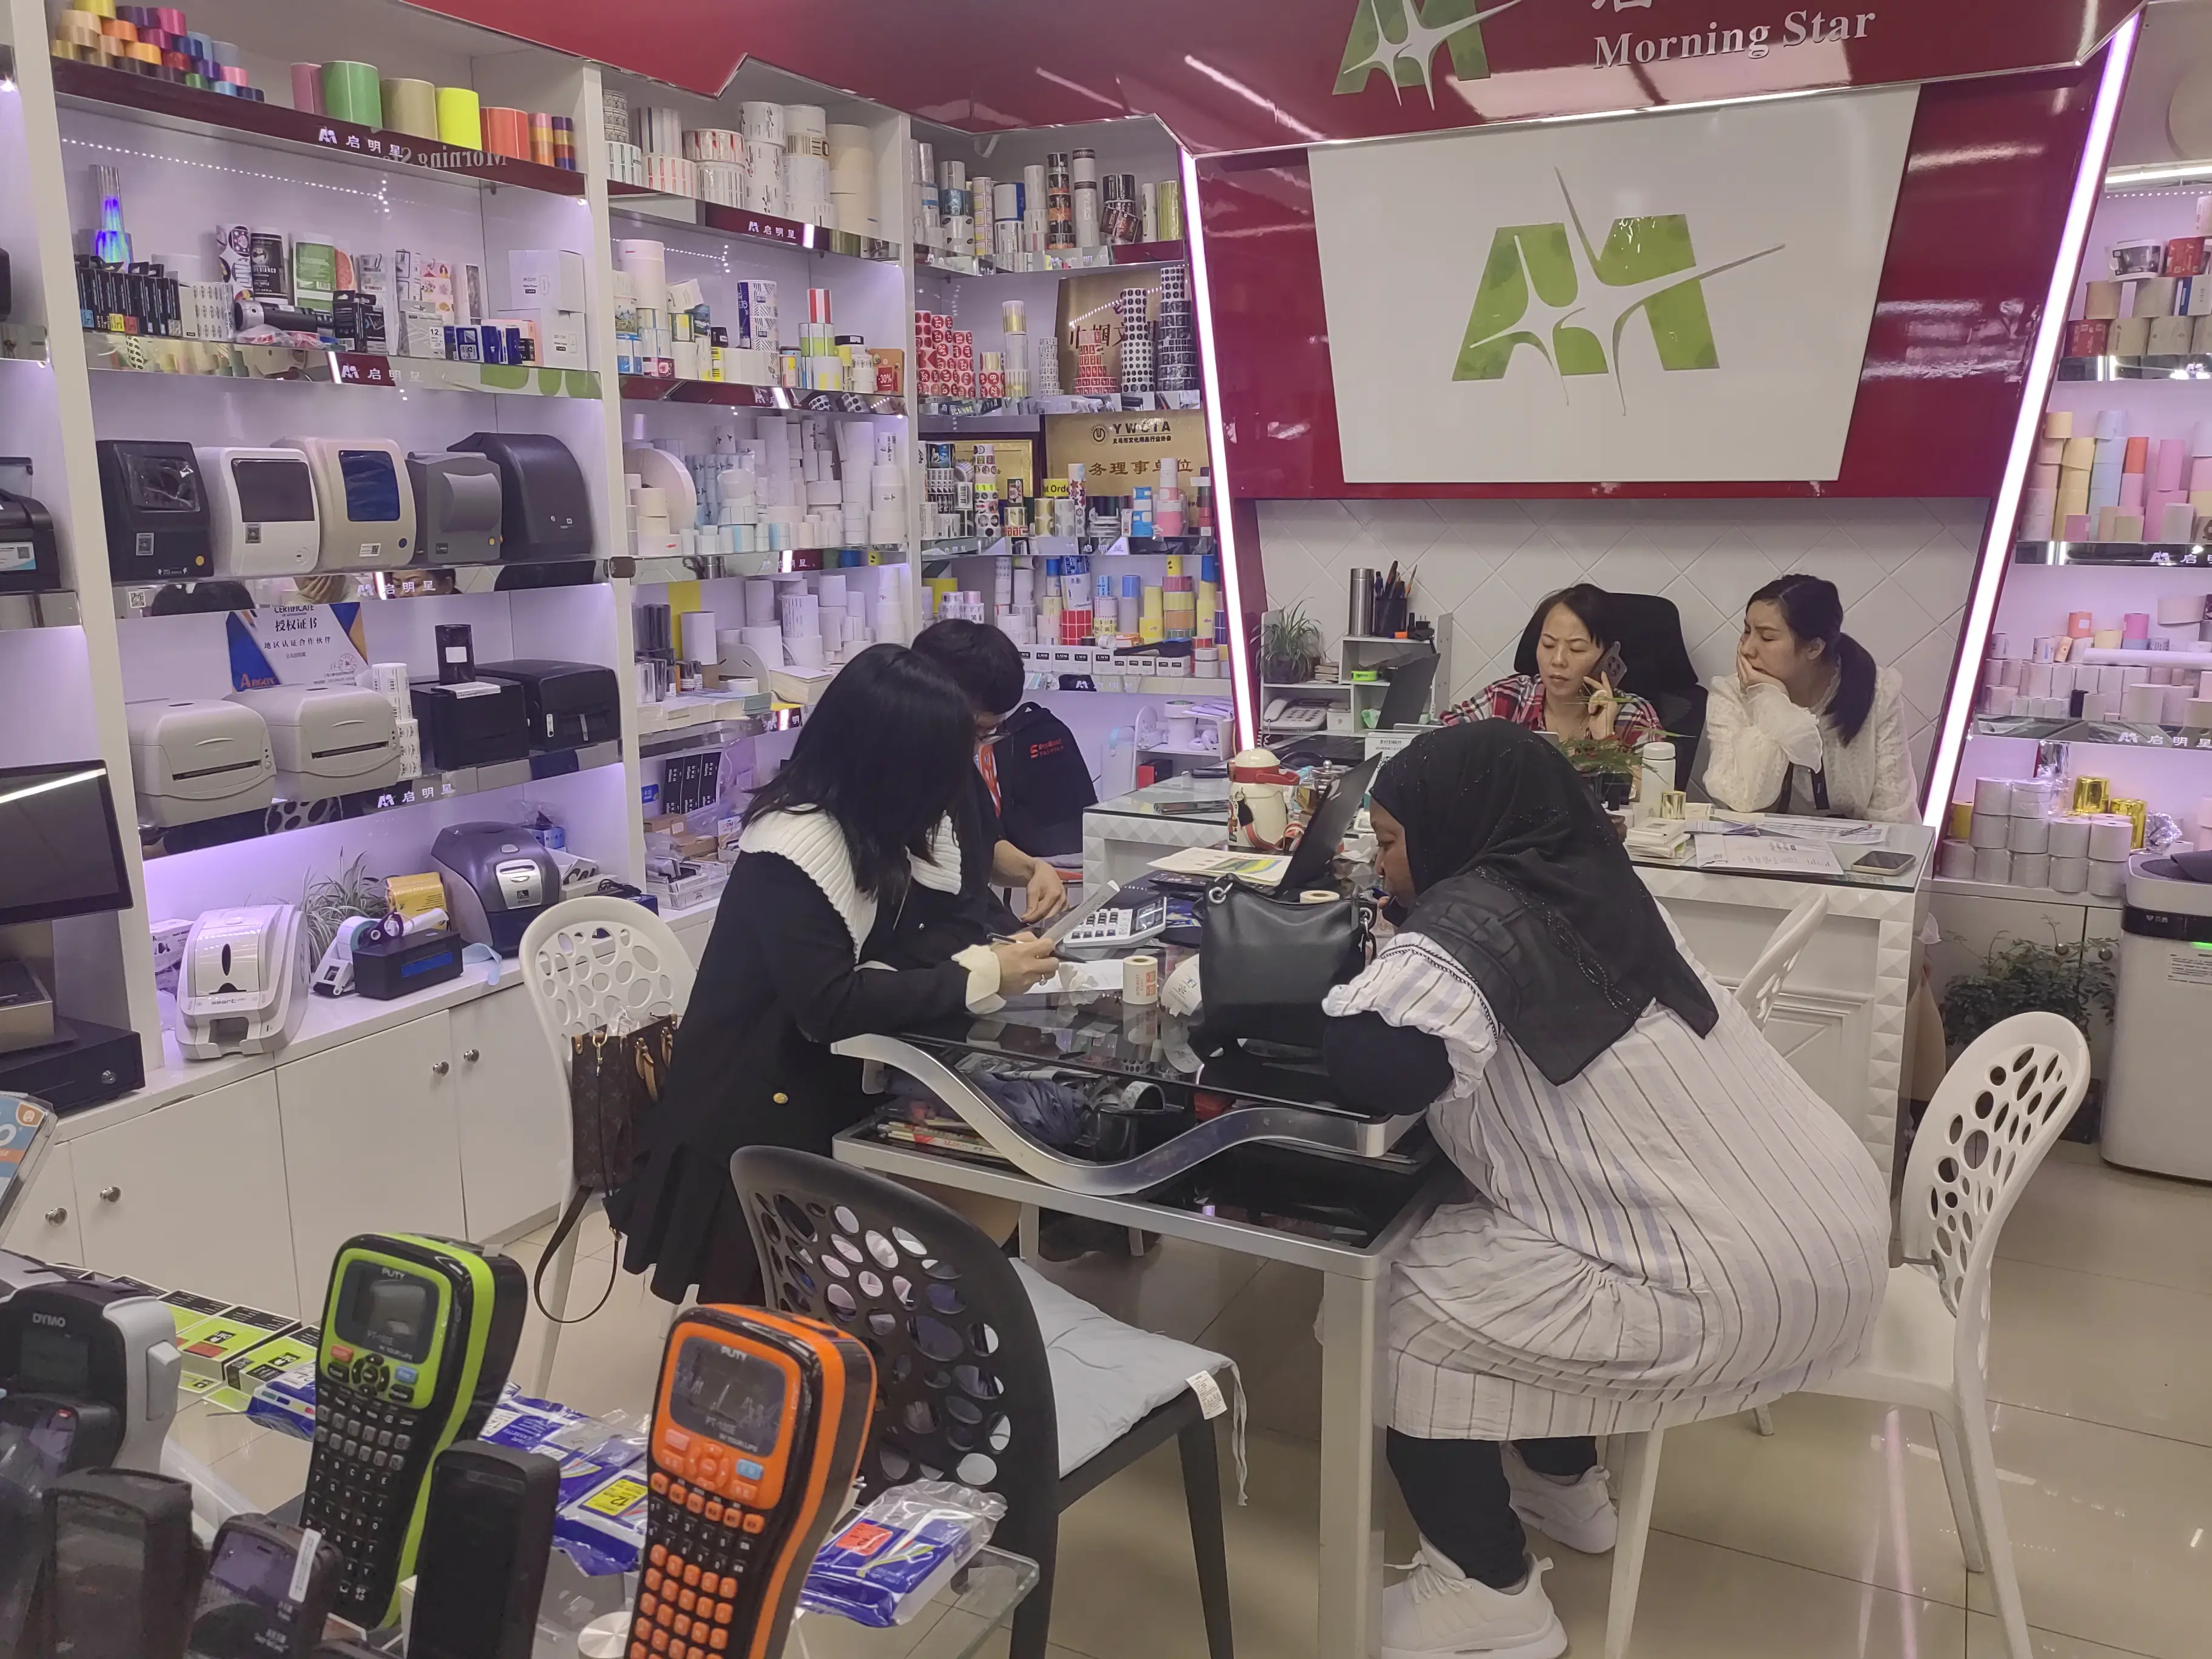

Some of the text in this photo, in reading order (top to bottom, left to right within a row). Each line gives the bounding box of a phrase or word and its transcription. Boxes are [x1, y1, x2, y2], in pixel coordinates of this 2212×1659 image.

[1594, 10, 1876, 69] Morning Star
[346, 135, 403, 158] 启明星
[275, 617, 317, 632] 授权证书
[264, 635, 331, 649] 地区认证合作伙伴
[2147, 734, 2212, 749] 启明星
[401, 783, 457, 803] 启明星
[33, 1313, 65, 1327] DYMO
[611, 1495, 629, 1506] 12
